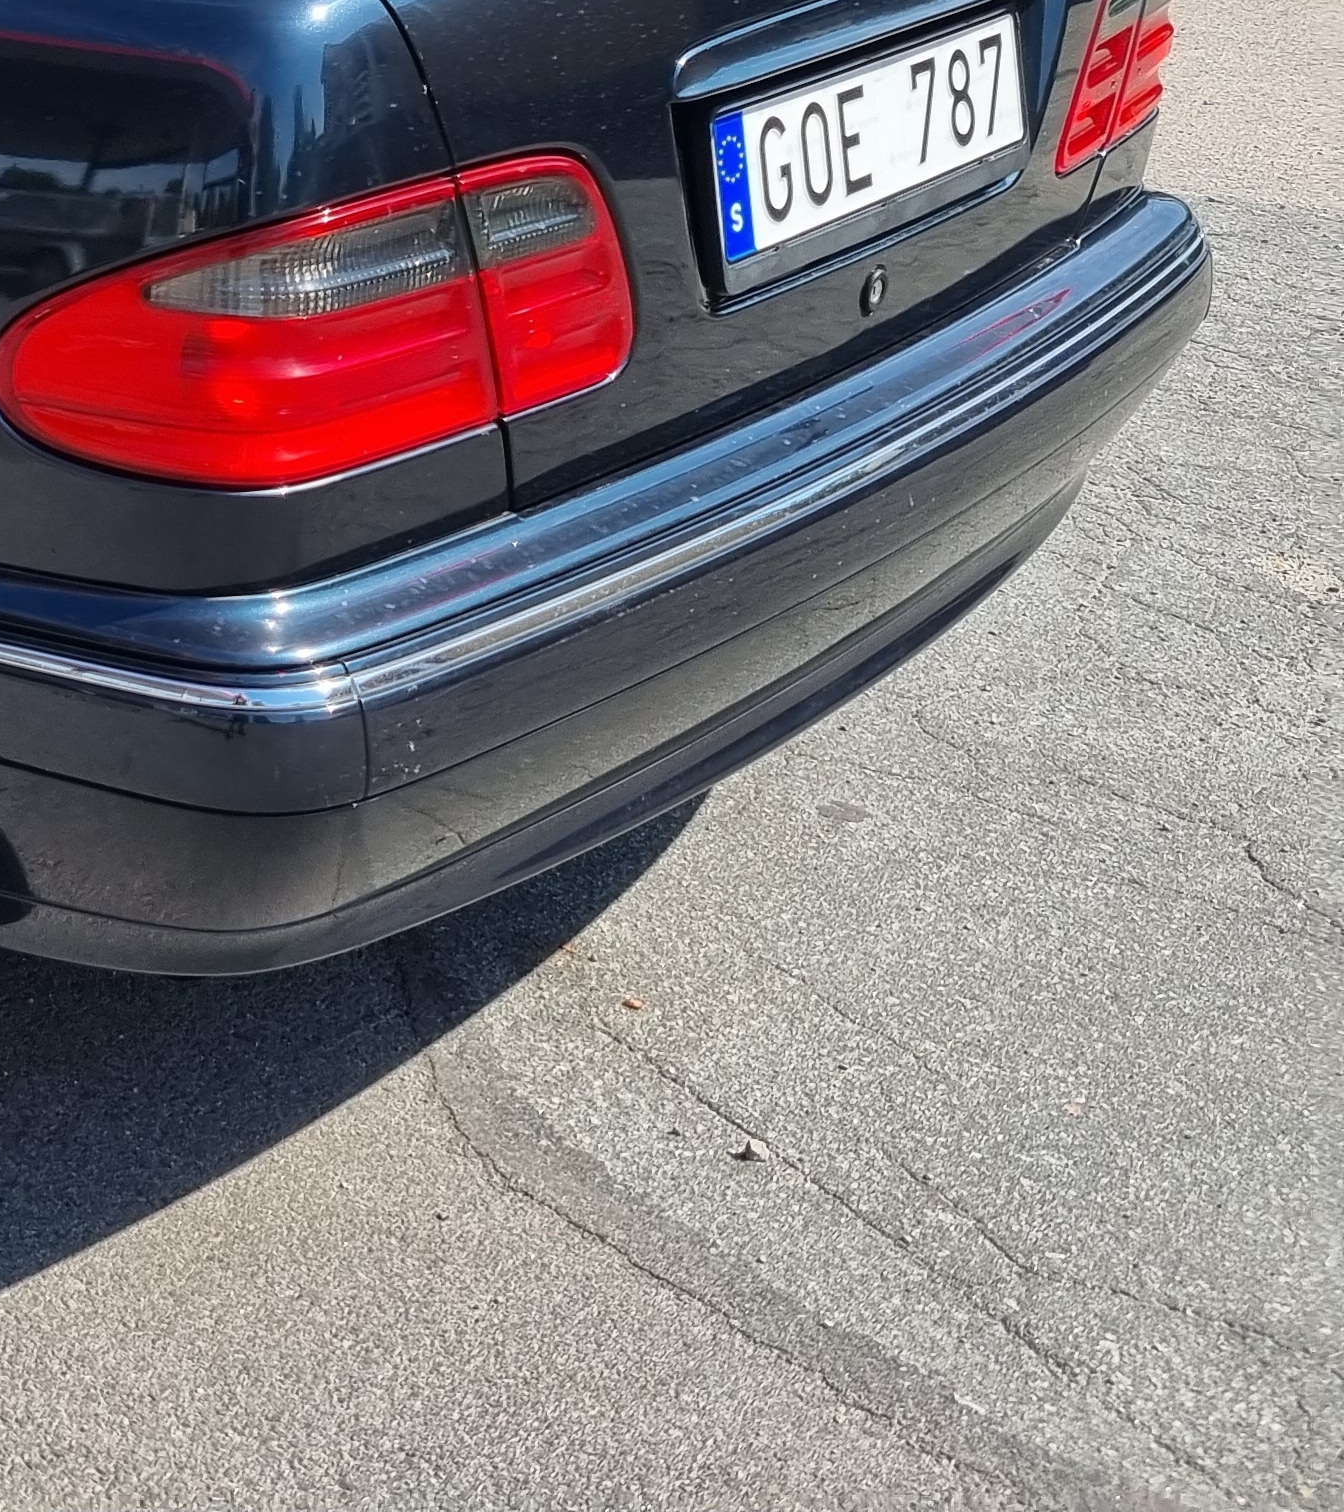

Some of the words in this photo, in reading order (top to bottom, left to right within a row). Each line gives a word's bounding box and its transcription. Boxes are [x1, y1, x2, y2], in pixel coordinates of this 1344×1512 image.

[760, 84, 873, 222] GOE
[909, 32, 1003, 166] 787
[730, 202, 744, 233] S
